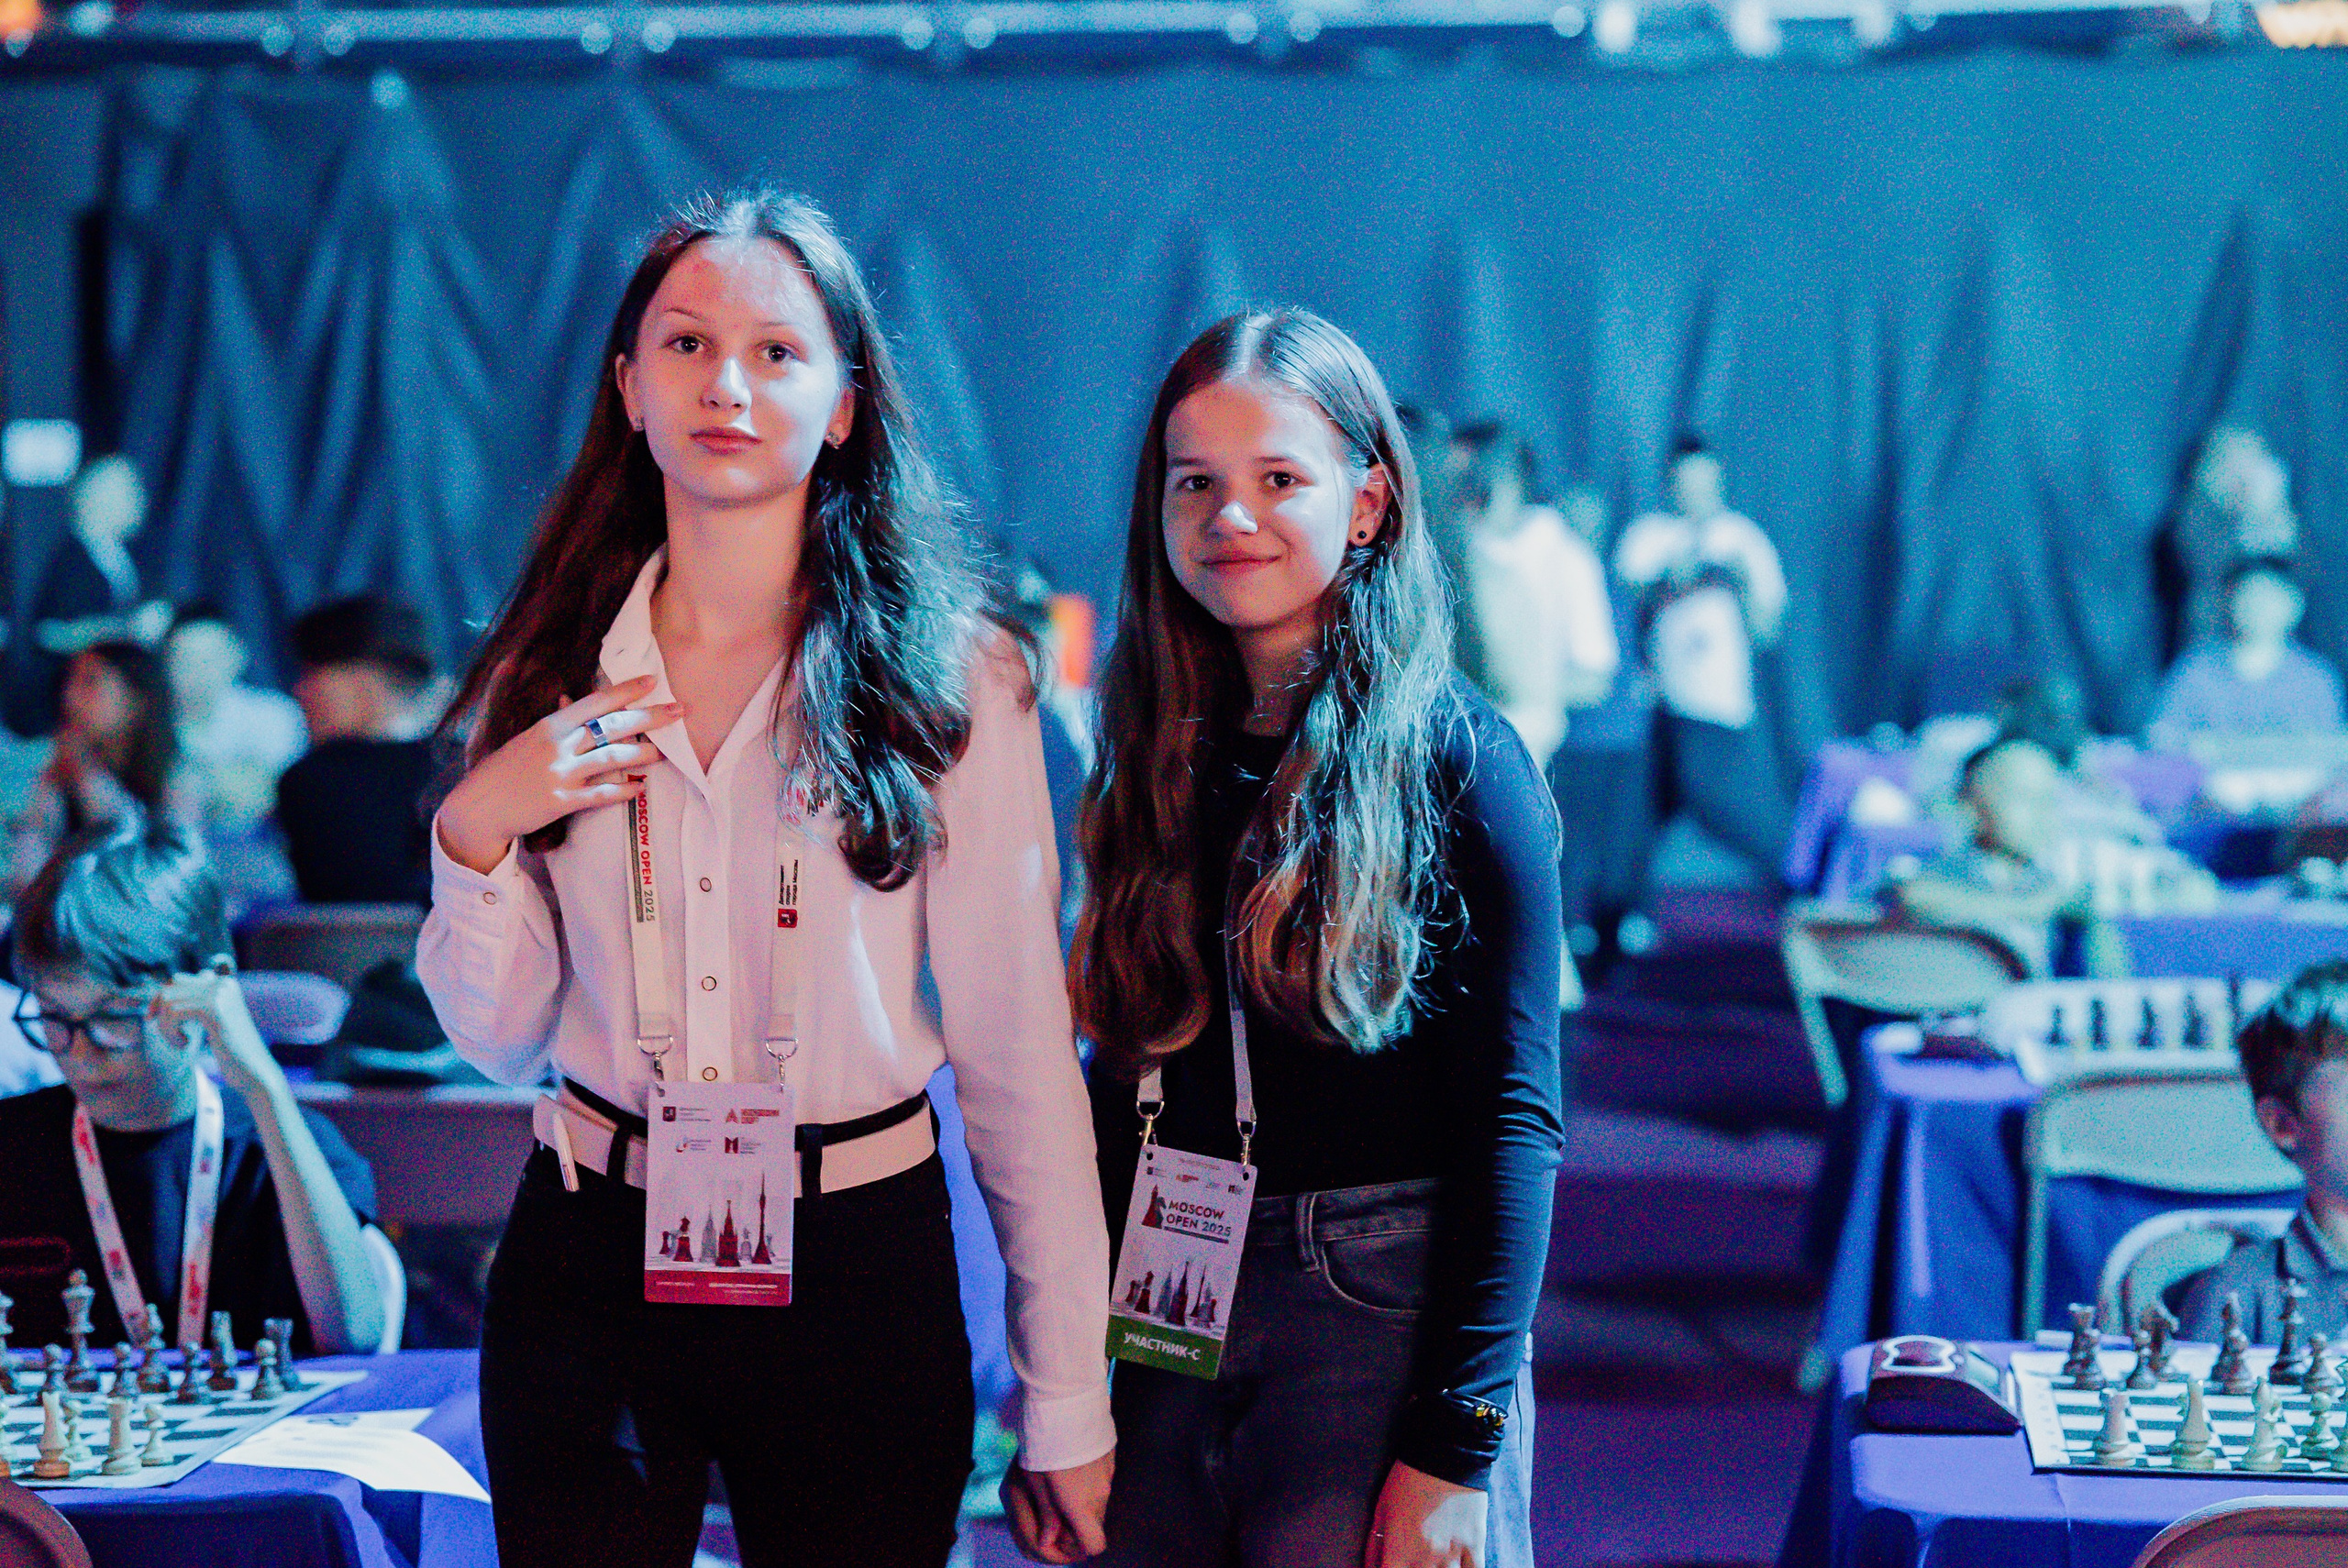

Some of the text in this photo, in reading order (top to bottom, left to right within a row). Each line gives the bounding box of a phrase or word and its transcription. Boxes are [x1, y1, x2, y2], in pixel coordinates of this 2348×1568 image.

[640, 850, 652, 884] OPEN
[644, 889, 655, 922] 2025
[1168, 1199, 1224, 1220] MOSCOW
[1166, 1213, 1232, 1237] OPEN 2025
[1124, 1331, 1202, 1361] УЧАСТНИК-С
